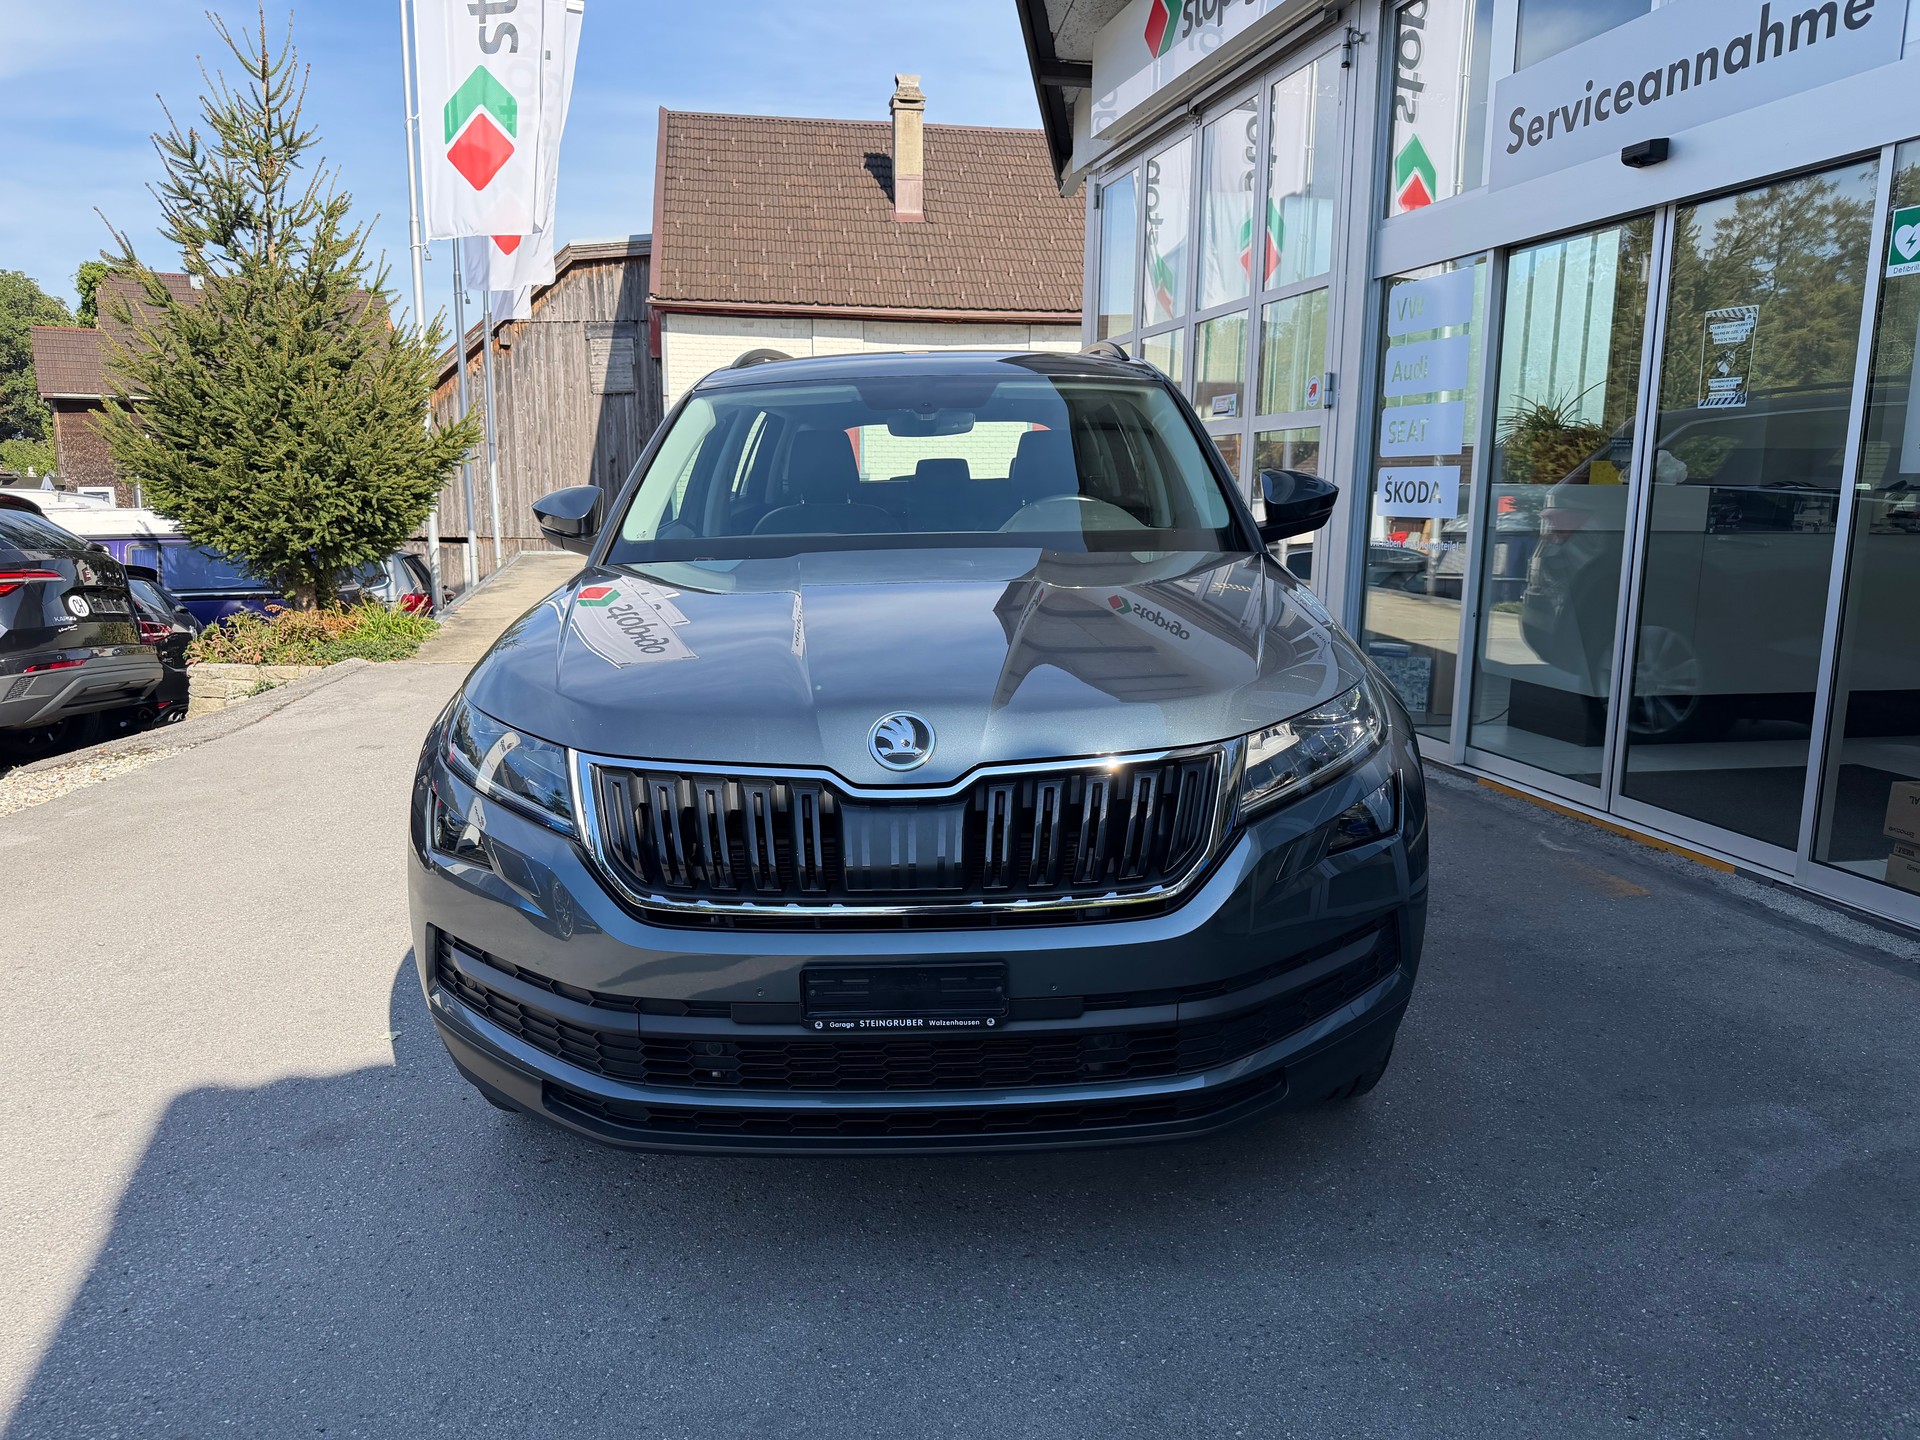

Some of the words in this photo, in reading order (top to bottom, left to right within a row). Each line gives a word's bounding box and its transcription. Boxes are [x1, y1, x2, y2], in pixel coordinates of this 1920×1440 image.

[1505, 0, 1876, 155] Serviceannahme
[1396, 295, 1425, 321] VW
[1391, 355, 1429, 383] Audi
[1388, 418, 1429, 444] SEAT
[1384, 475, 1442, 504] ŠKODA
[72, 598, 87, 614] CH
[829, 1021, 855, 1029] Garage
[859, 1019, 924, 1027] STEINGRUBER
